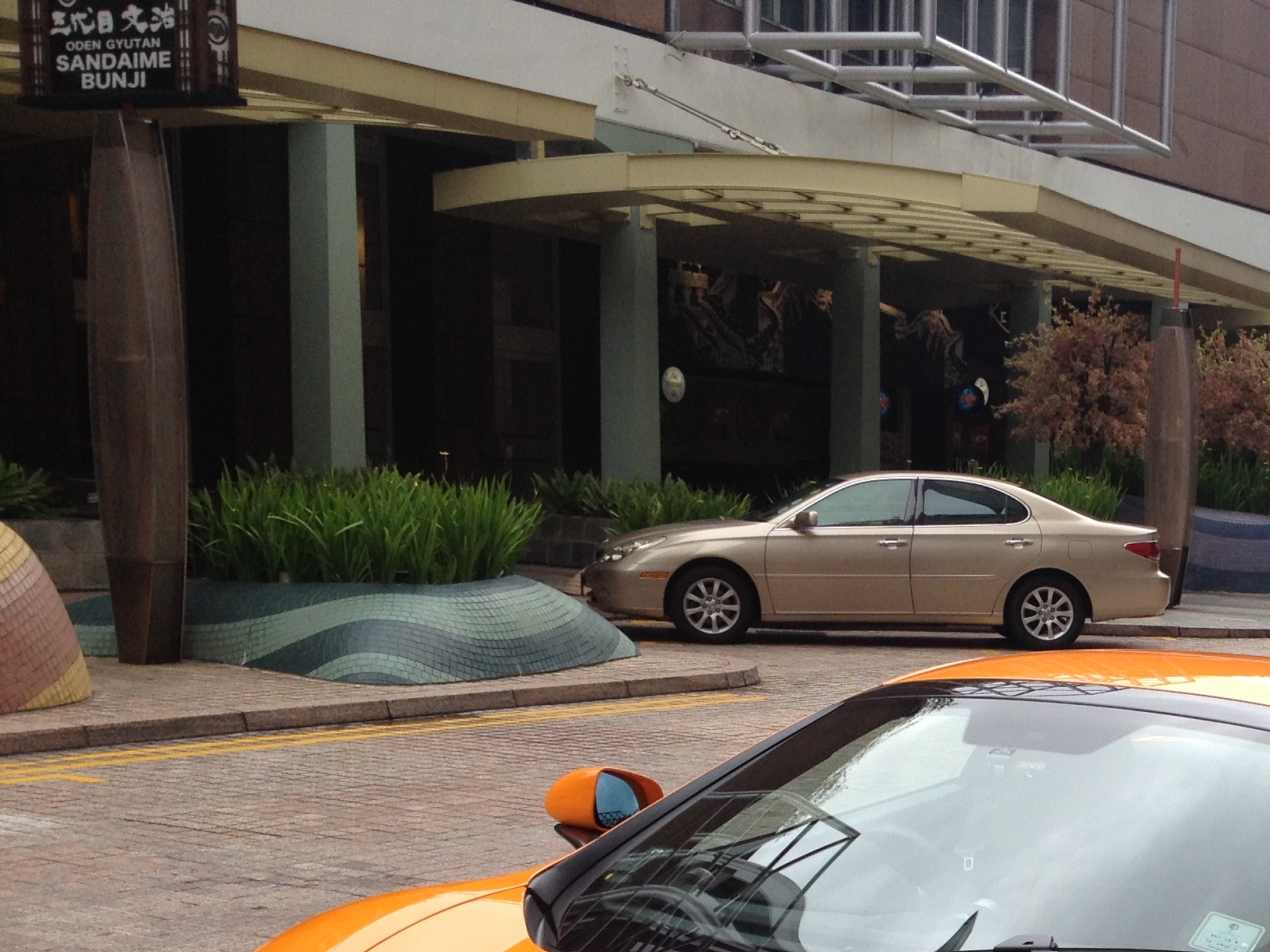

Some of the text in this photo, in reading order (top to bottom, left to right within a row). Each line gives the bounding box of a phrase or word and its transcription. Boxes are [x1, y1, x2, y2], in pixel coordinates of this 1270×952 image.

[66, 37, 161, 52] ODEN GYUTAN
[56, 51, 172, 72] SANDAIME
[81, 71, 147, 90] BUNJI
